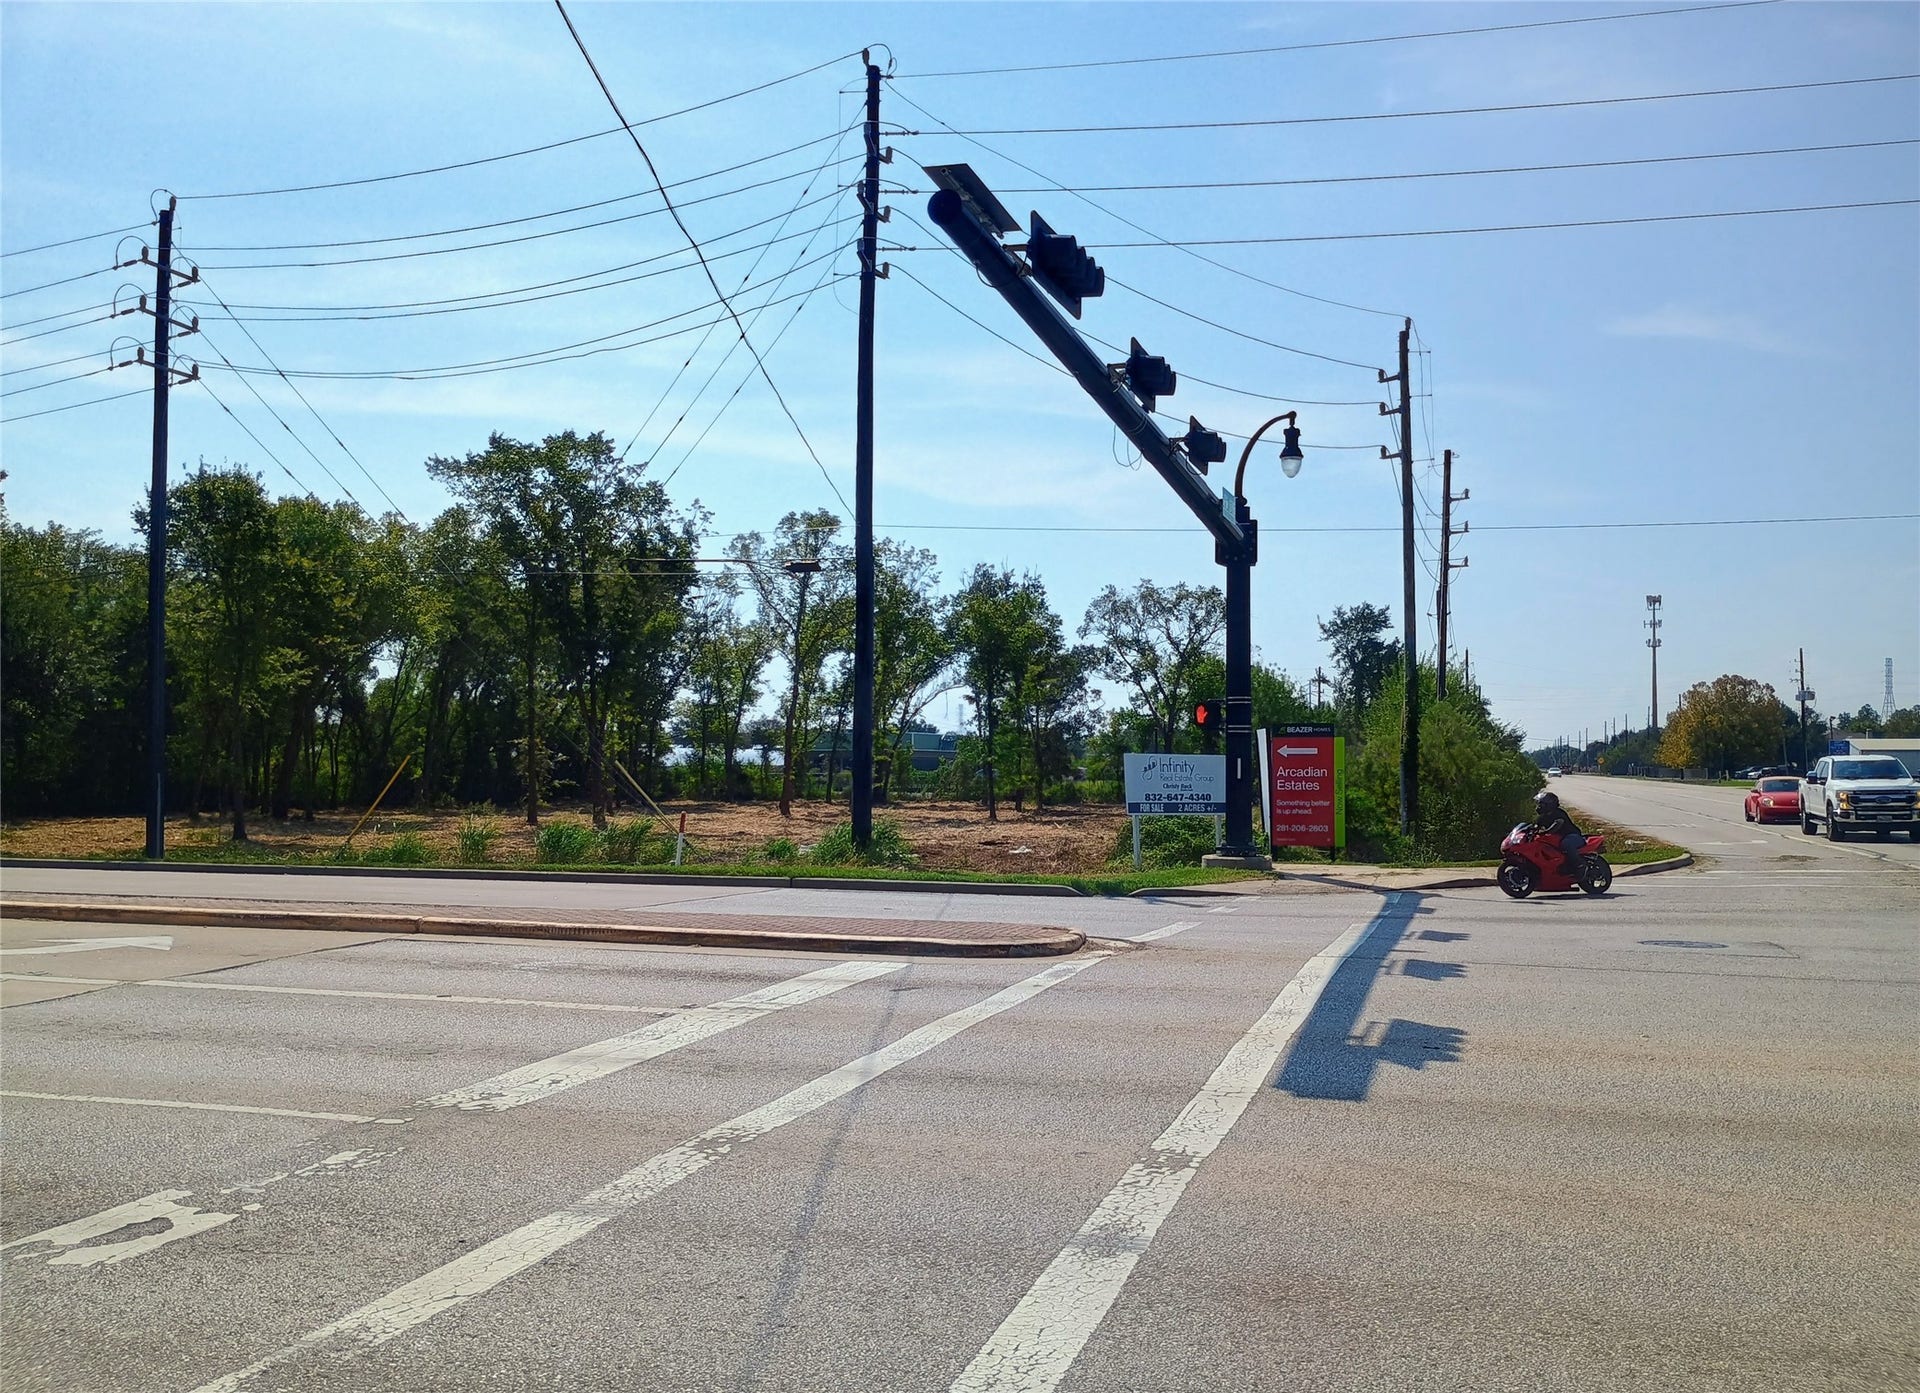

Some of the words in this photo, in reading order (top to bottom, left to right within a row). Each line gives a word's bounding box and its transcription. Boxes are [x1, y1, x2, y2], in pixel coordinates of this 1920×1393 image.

[1160, 757, 1195, 775] Infinity
[1276, 766, 1328, 777] Arcadian
[1160, 774, 1173, 782] Real
[1175, 774, 1193, 782] Estate
[1195, 774, 1214, 783] Group
[1277, 780, 1320, 791] Estates
[1144, 793, 1212, 802] 832-647-4340
[1139, 804, 1150, 812] FOR
[1151, 804, 1164, 813] SALE
[1184, 804, 1206, 812] ACRES
[1335, 795, 1344, 816] Now
